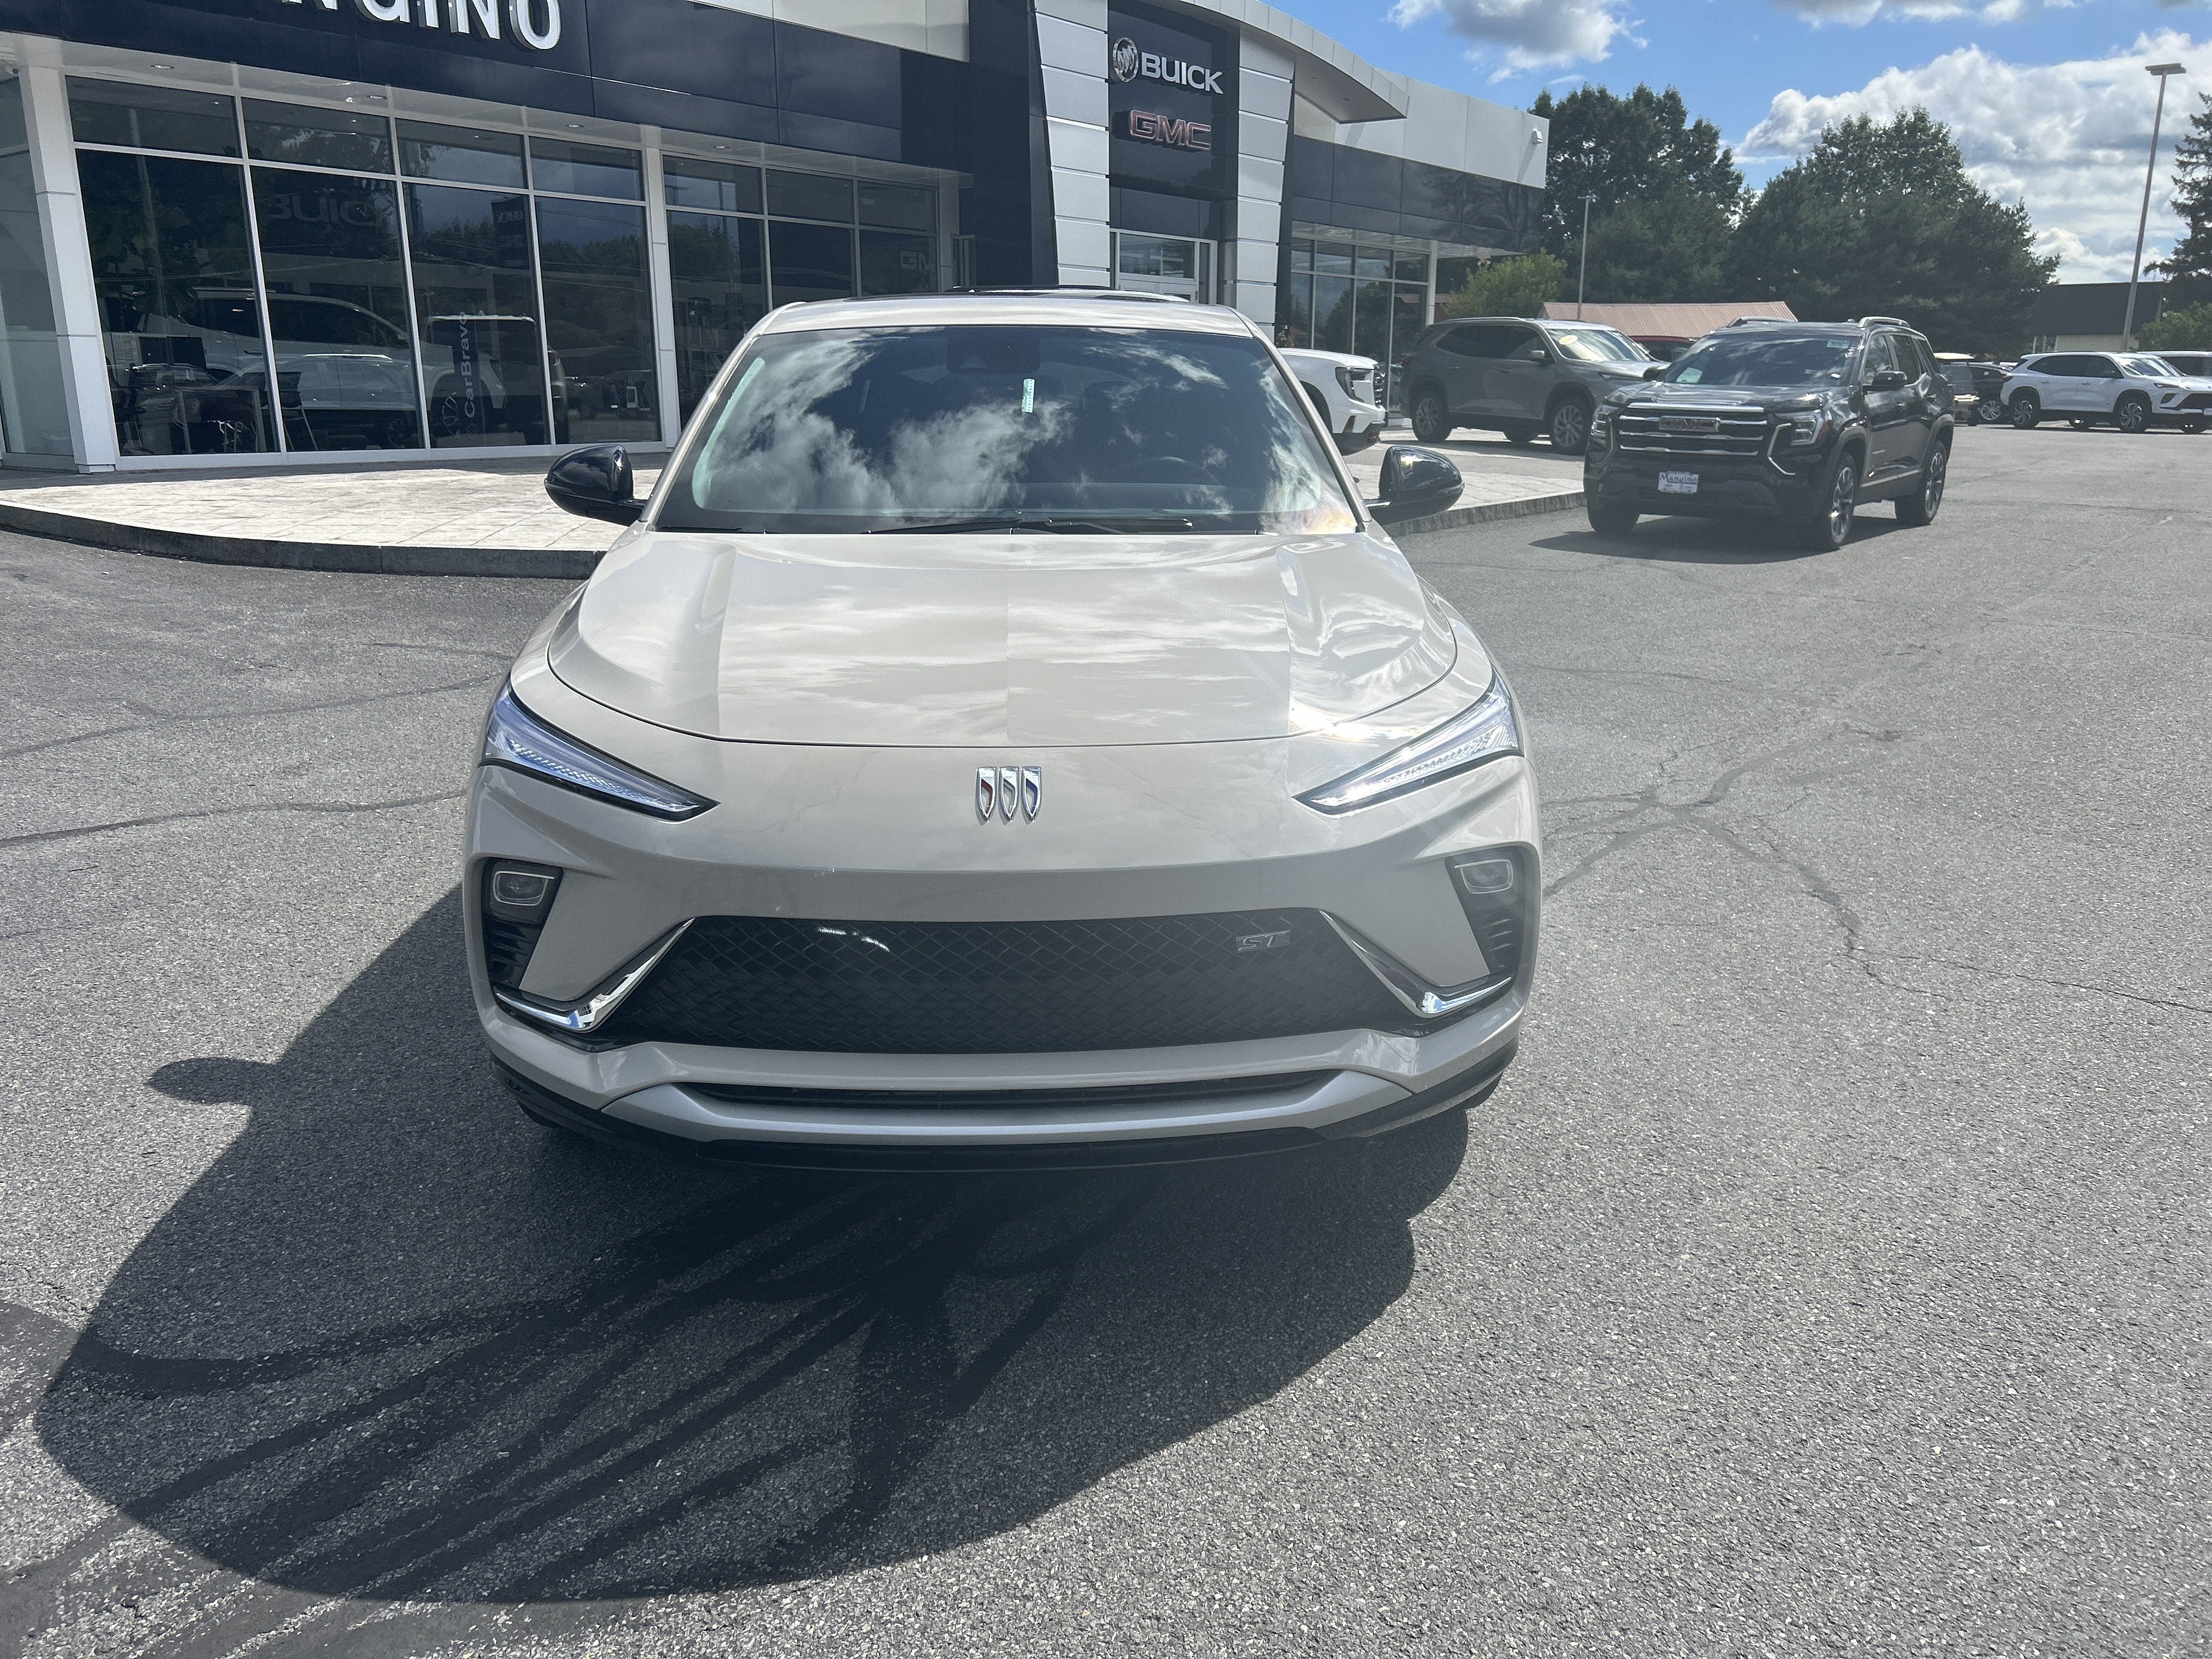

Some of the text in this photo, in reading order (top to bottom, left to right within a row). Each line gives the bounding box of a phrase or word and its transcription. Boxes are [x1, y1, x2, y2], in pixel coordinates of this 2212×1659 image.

[1141, 52, 1223, 94] BUICK
[1130, 110, 1211, 150] GMC
[262, 192, 390, 227] BUIC
[459, 311, 475, 417] CarBravo
[1660, 417, 1715, 431] GMC
[1238, 931, 1288, 951] ST
